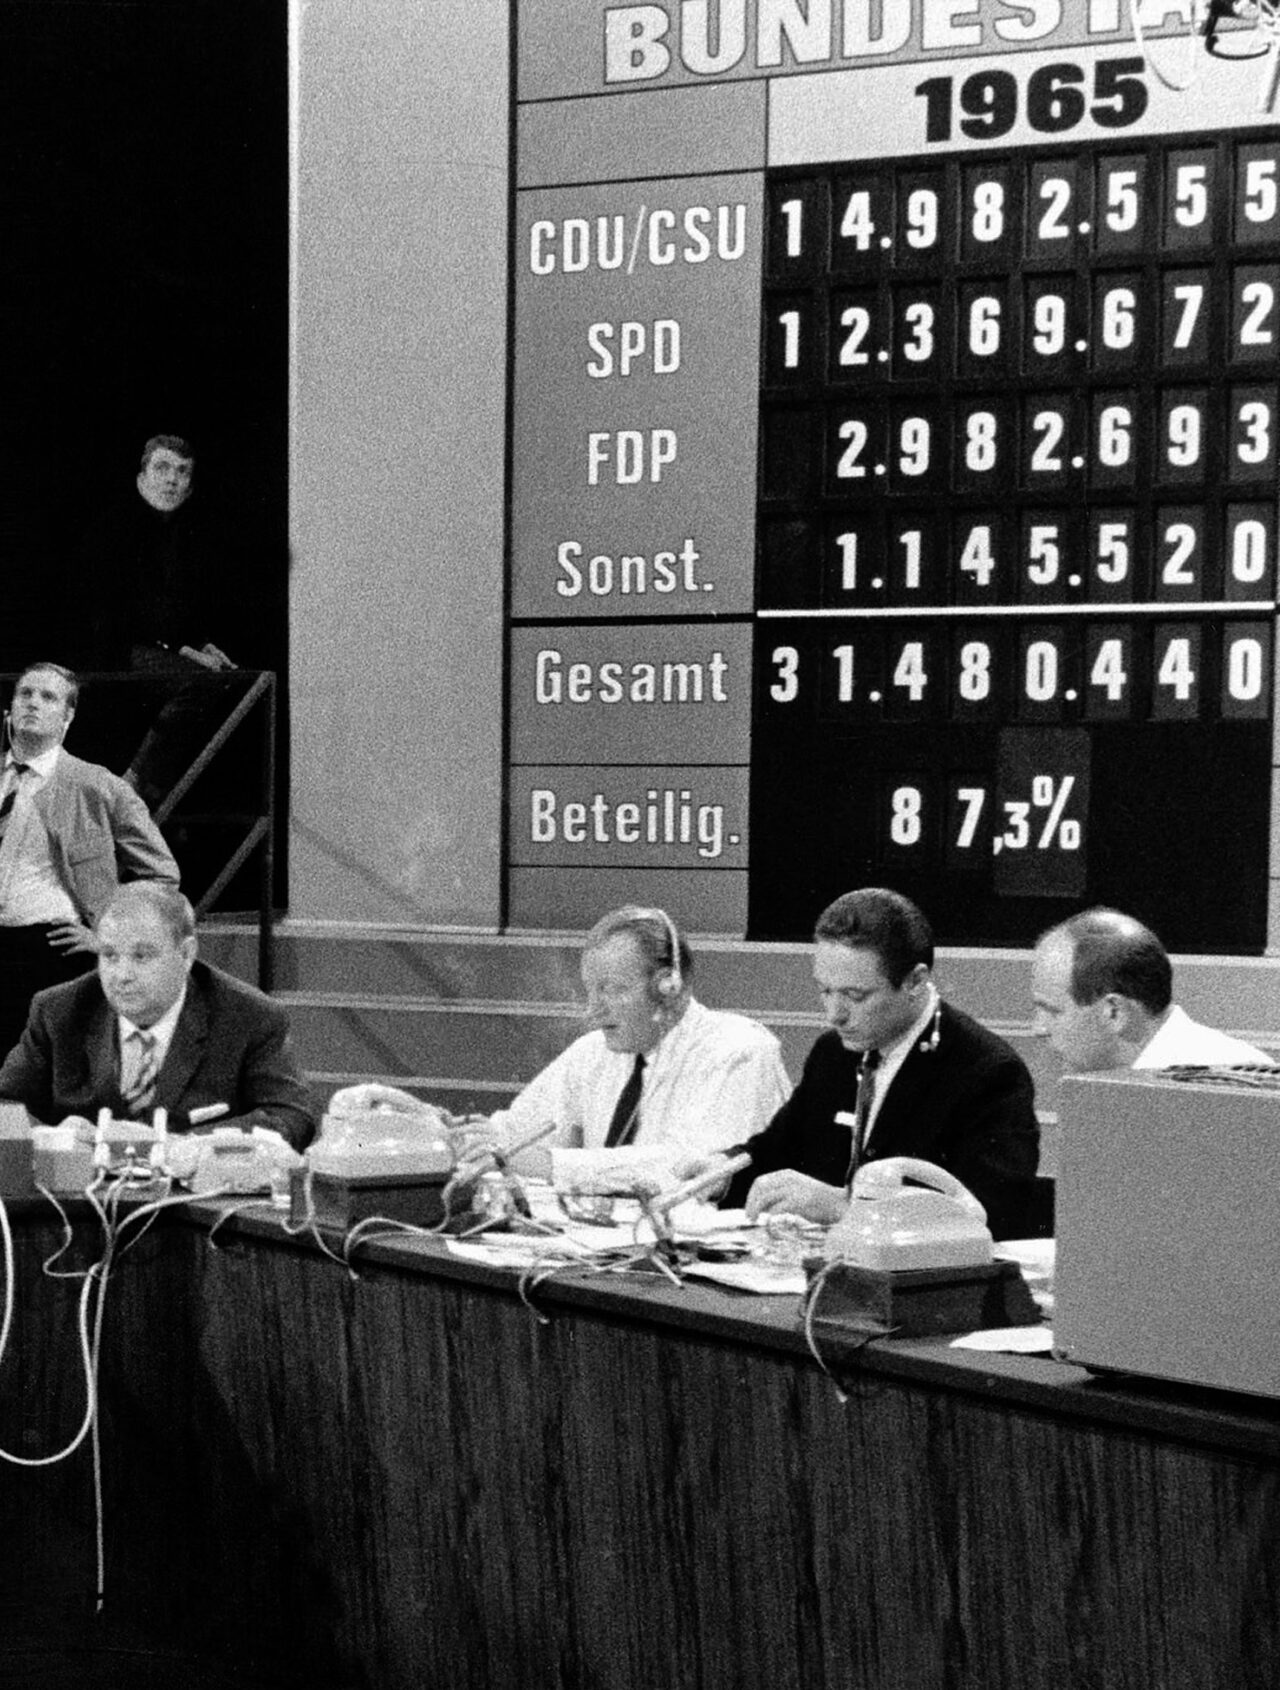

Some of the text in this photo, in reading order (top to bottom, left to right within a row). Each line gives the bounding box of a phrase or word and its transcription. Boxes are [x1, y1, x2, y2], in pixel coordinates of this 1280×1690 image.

[914, 56, 1149, 143] 1965
[530, 204, 748, 275] CDU/CSU
[587, 320, 682, 379] SPD
[588, 429, 678, 485] FDP
[556, 538, 714, 598] Sonst.
[535, 650, 729, 704] Gesamt
[530, 788, 740, 858] Beteilig.
